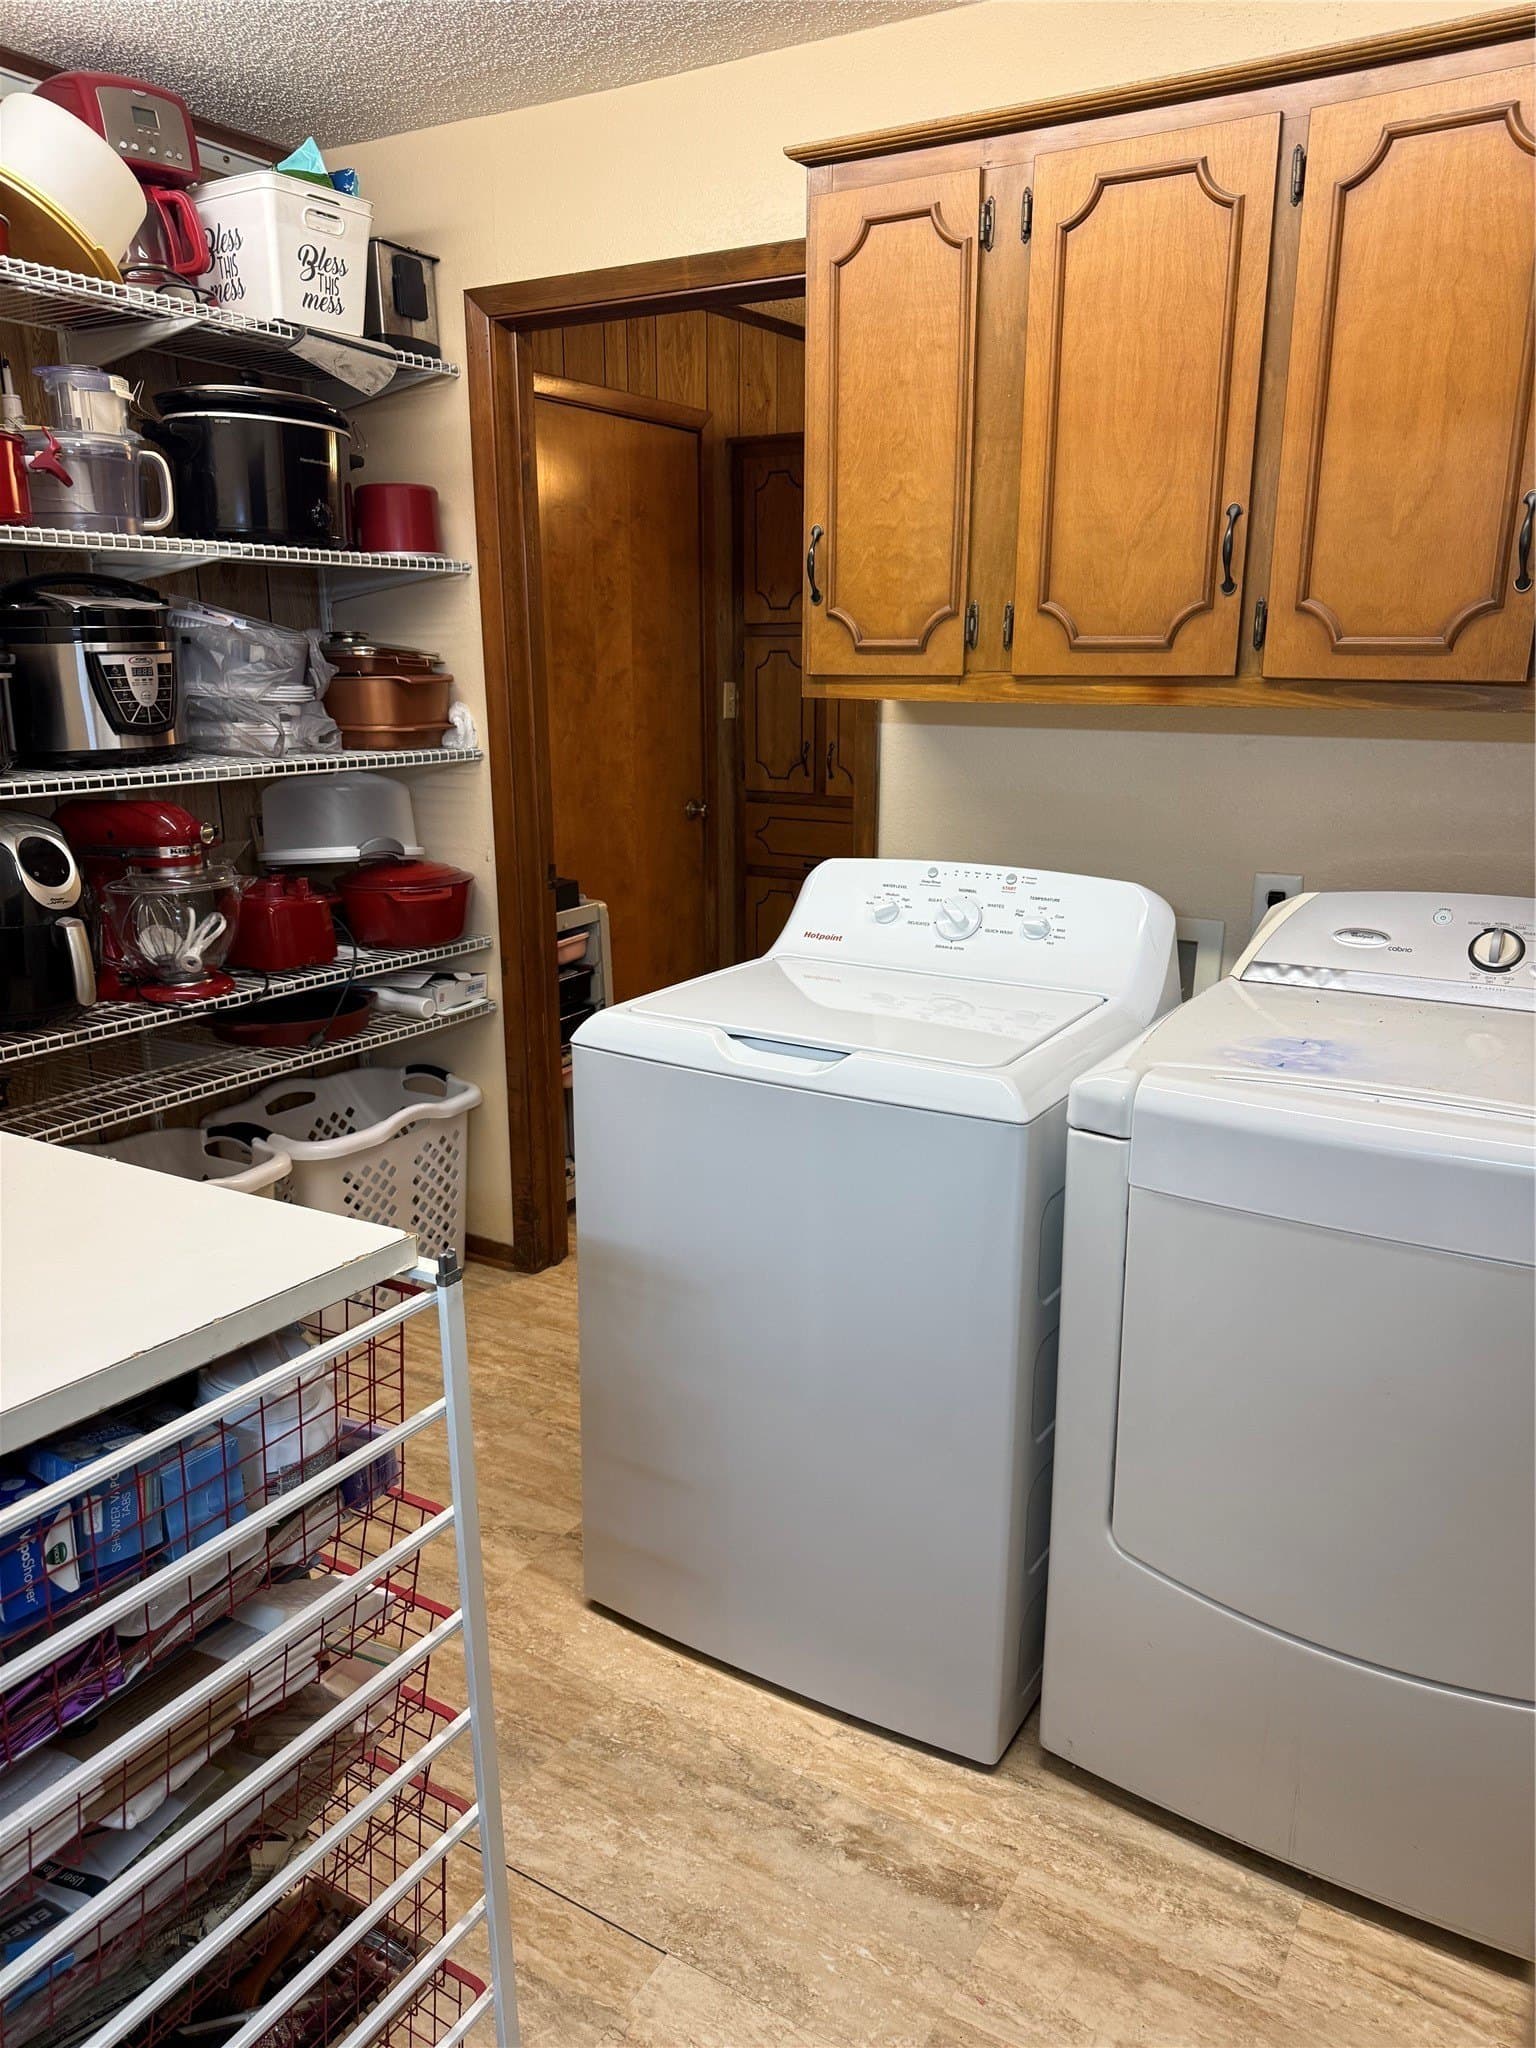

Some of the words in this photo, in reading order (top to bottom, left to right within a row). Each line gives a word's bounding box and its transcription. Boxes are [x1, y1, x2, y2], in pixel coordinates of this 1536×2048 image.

[216, 253, 238, 279] THIS
[298, 243, 348, 281] Bless
[317, 272, 339, 297] THIS
[302, 291, 345, 315] mess
[803, 931, 843, 942] Hotpoint
[121, 1491, 132, 1518] TABS
[60, 1872, 85, 1887] User
